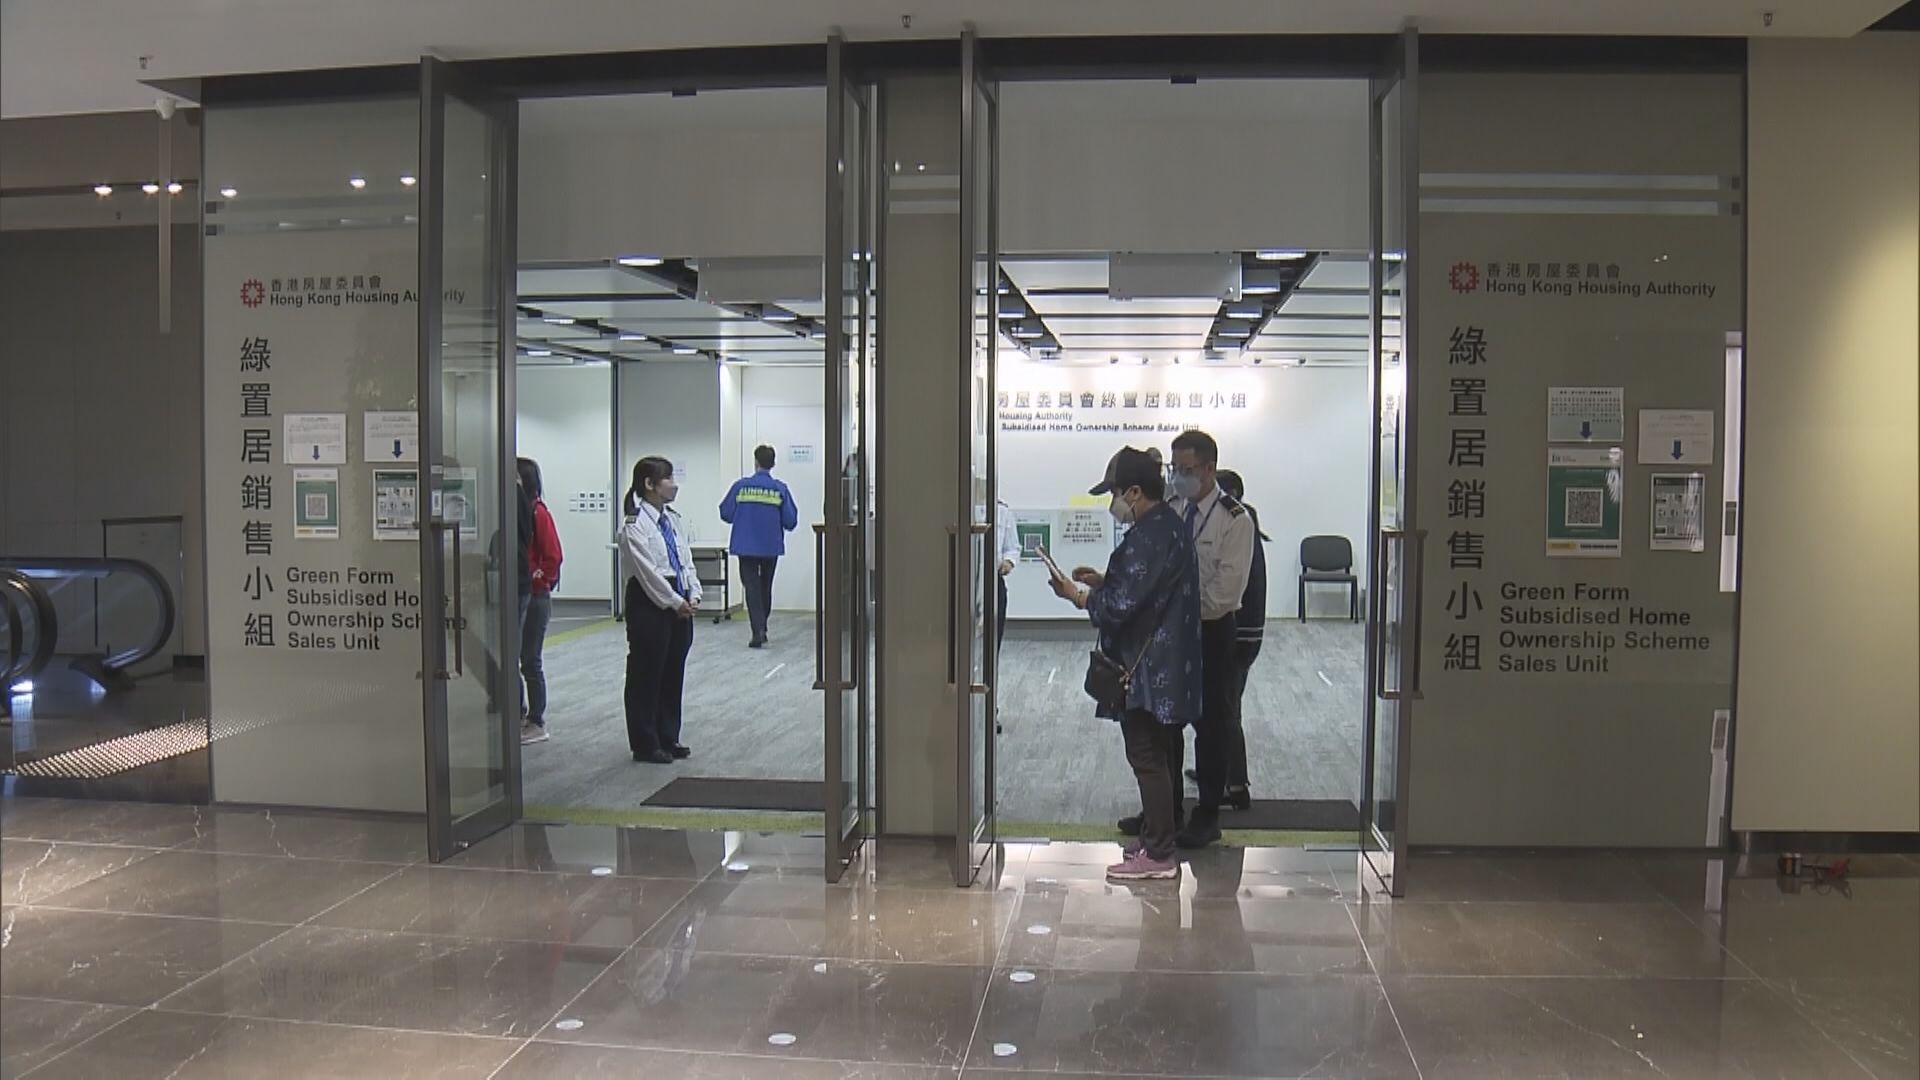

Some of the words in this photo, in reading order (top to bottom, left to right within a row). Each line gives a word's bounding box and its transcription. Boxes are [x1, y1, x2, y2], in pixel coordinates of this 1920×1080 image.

[1487, 263, 1621, 279] 香港房屋委員會
[271, 275, 382, 292] 香港房屋委員會
[1486, 280, 1526, 296] Hong
[1532, 280, 1572, 296] Kong
[1578, 281, 1641, 297] Housing
[1646, 281, 1716, 298] Authority
[270, 293, 303, 308] Hong
[308, 293, 341, 307] Kong
[346, 291, 399, 305] Housing
[403, 289, 465, 304] Aurity
[999, 412, 1032, 421] Housing
[1035, 411, 1072, 421] Authority
[1002, 423, 1047, 431] Subsidised
[1050, 423, 1073, 431] Home
[1076, 423, 1119, 432] Ownership
[240, 336, 276, 648] 綠置居銷售小組
[1444, 326, 1487, 672] 綠置居銷售小組
[286, 567, 340, 585] Green
[347, 568, 394, 585] Form
[286, 589, 387, 607] Subsidised
[395, 590, 451, 608] Hoe
[1501, 582, 1565, 601] Green
[1575, 583, 1630, 601] Form
[287, 610, 387, 631] Ownership
[1500, 606, 1621, 625] Subsidised
[1630, 607, 1691, 626] Home
[288, 633, 336, 650] Sales
[344, 634, 380, 651] Unit
[1499, 631, 1616, 653] Ownership
[1624, 631, 1710, 651] Scheme
[1498, 655, 1557, 673] Sales
[1566, 655, 1609, 673] Unit
